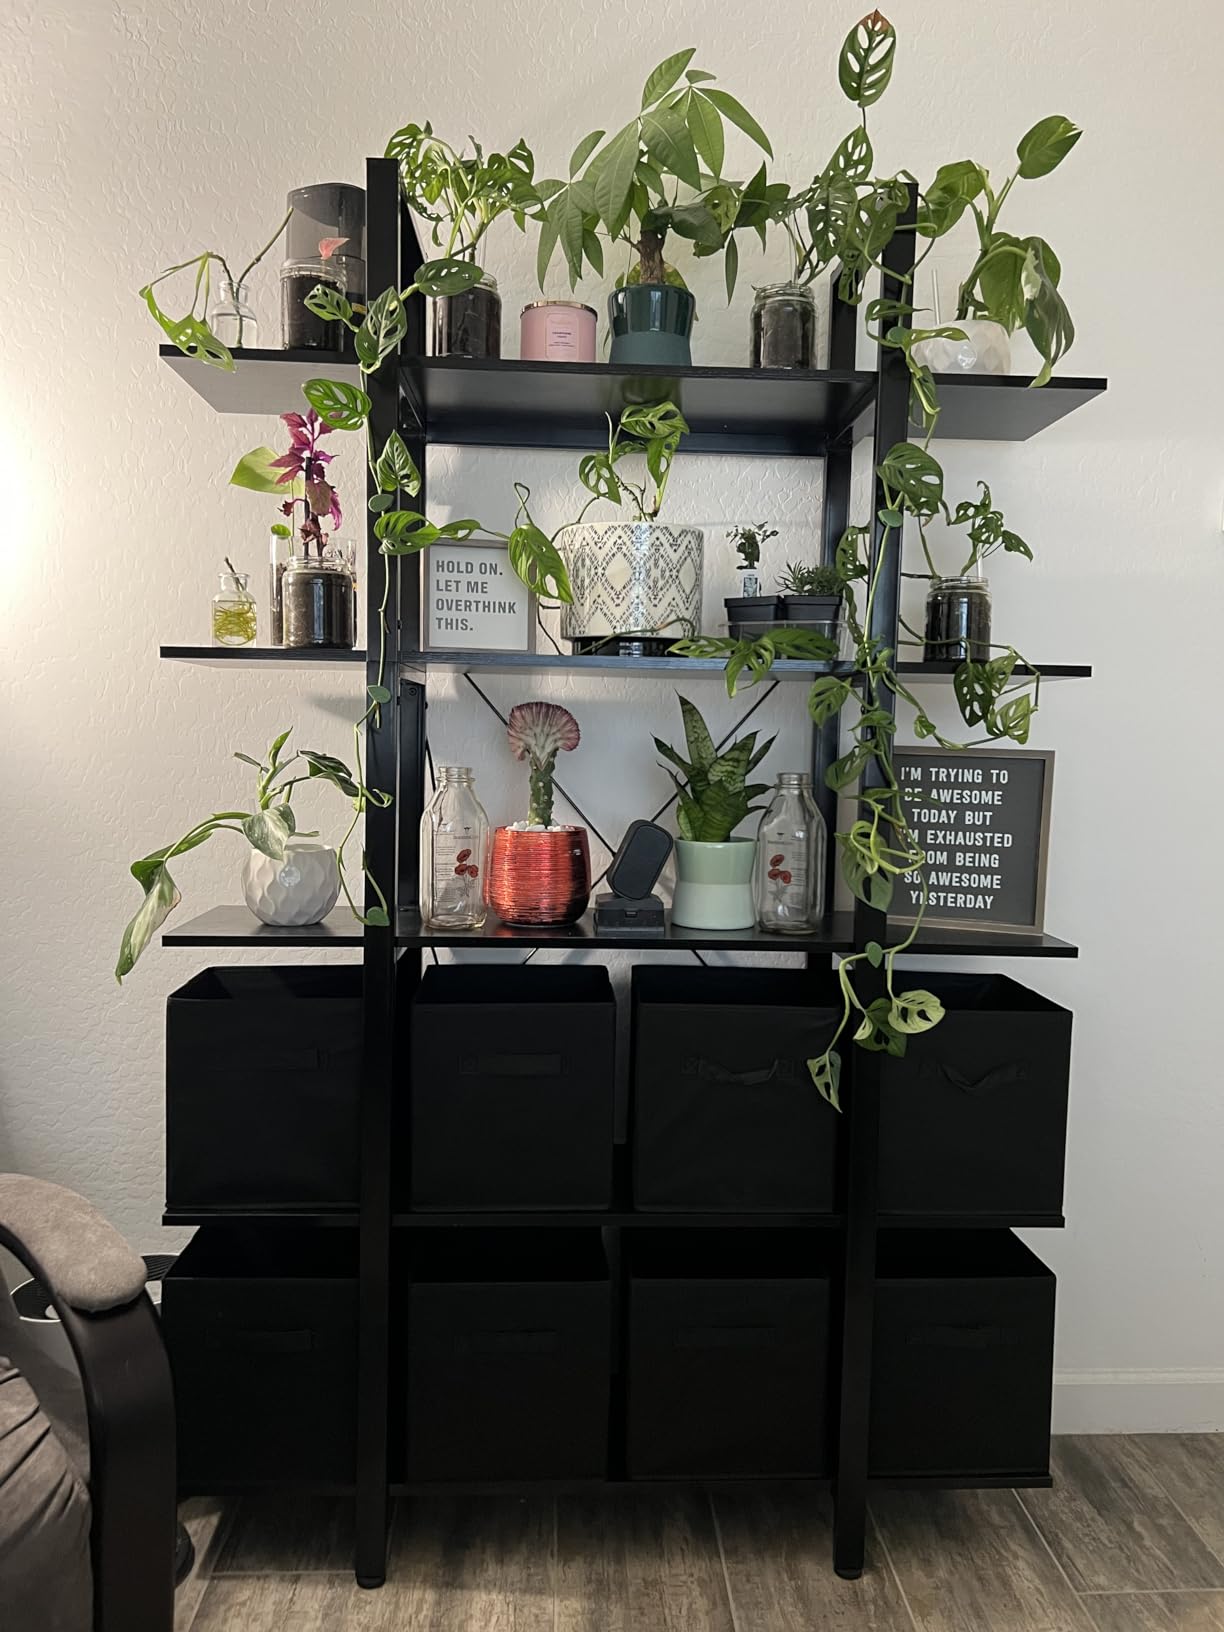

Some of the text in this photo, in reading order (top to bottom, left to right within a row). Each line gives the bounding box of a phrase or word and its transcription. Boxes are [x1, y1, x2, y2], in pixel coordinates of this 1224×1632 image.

[436, 560, 503, 576] HOLD ON.
[436, 579, 488, 594] LET ME
[435, 598, 517, 614] OVERTHINK
[436, 617, 473, 631] THIS.
[901, 767, 1009, 784] I'M TRYING TO
[930, 788, 1003, 805] AWESOME
[912, 808, 993, 826] TODAY BUT
[899, 828, 1013, 847] 'M EXHAUSTED
[955, 852, 1000, 868] BEING
[904, 870, 1002, 889] SO AWESOME
